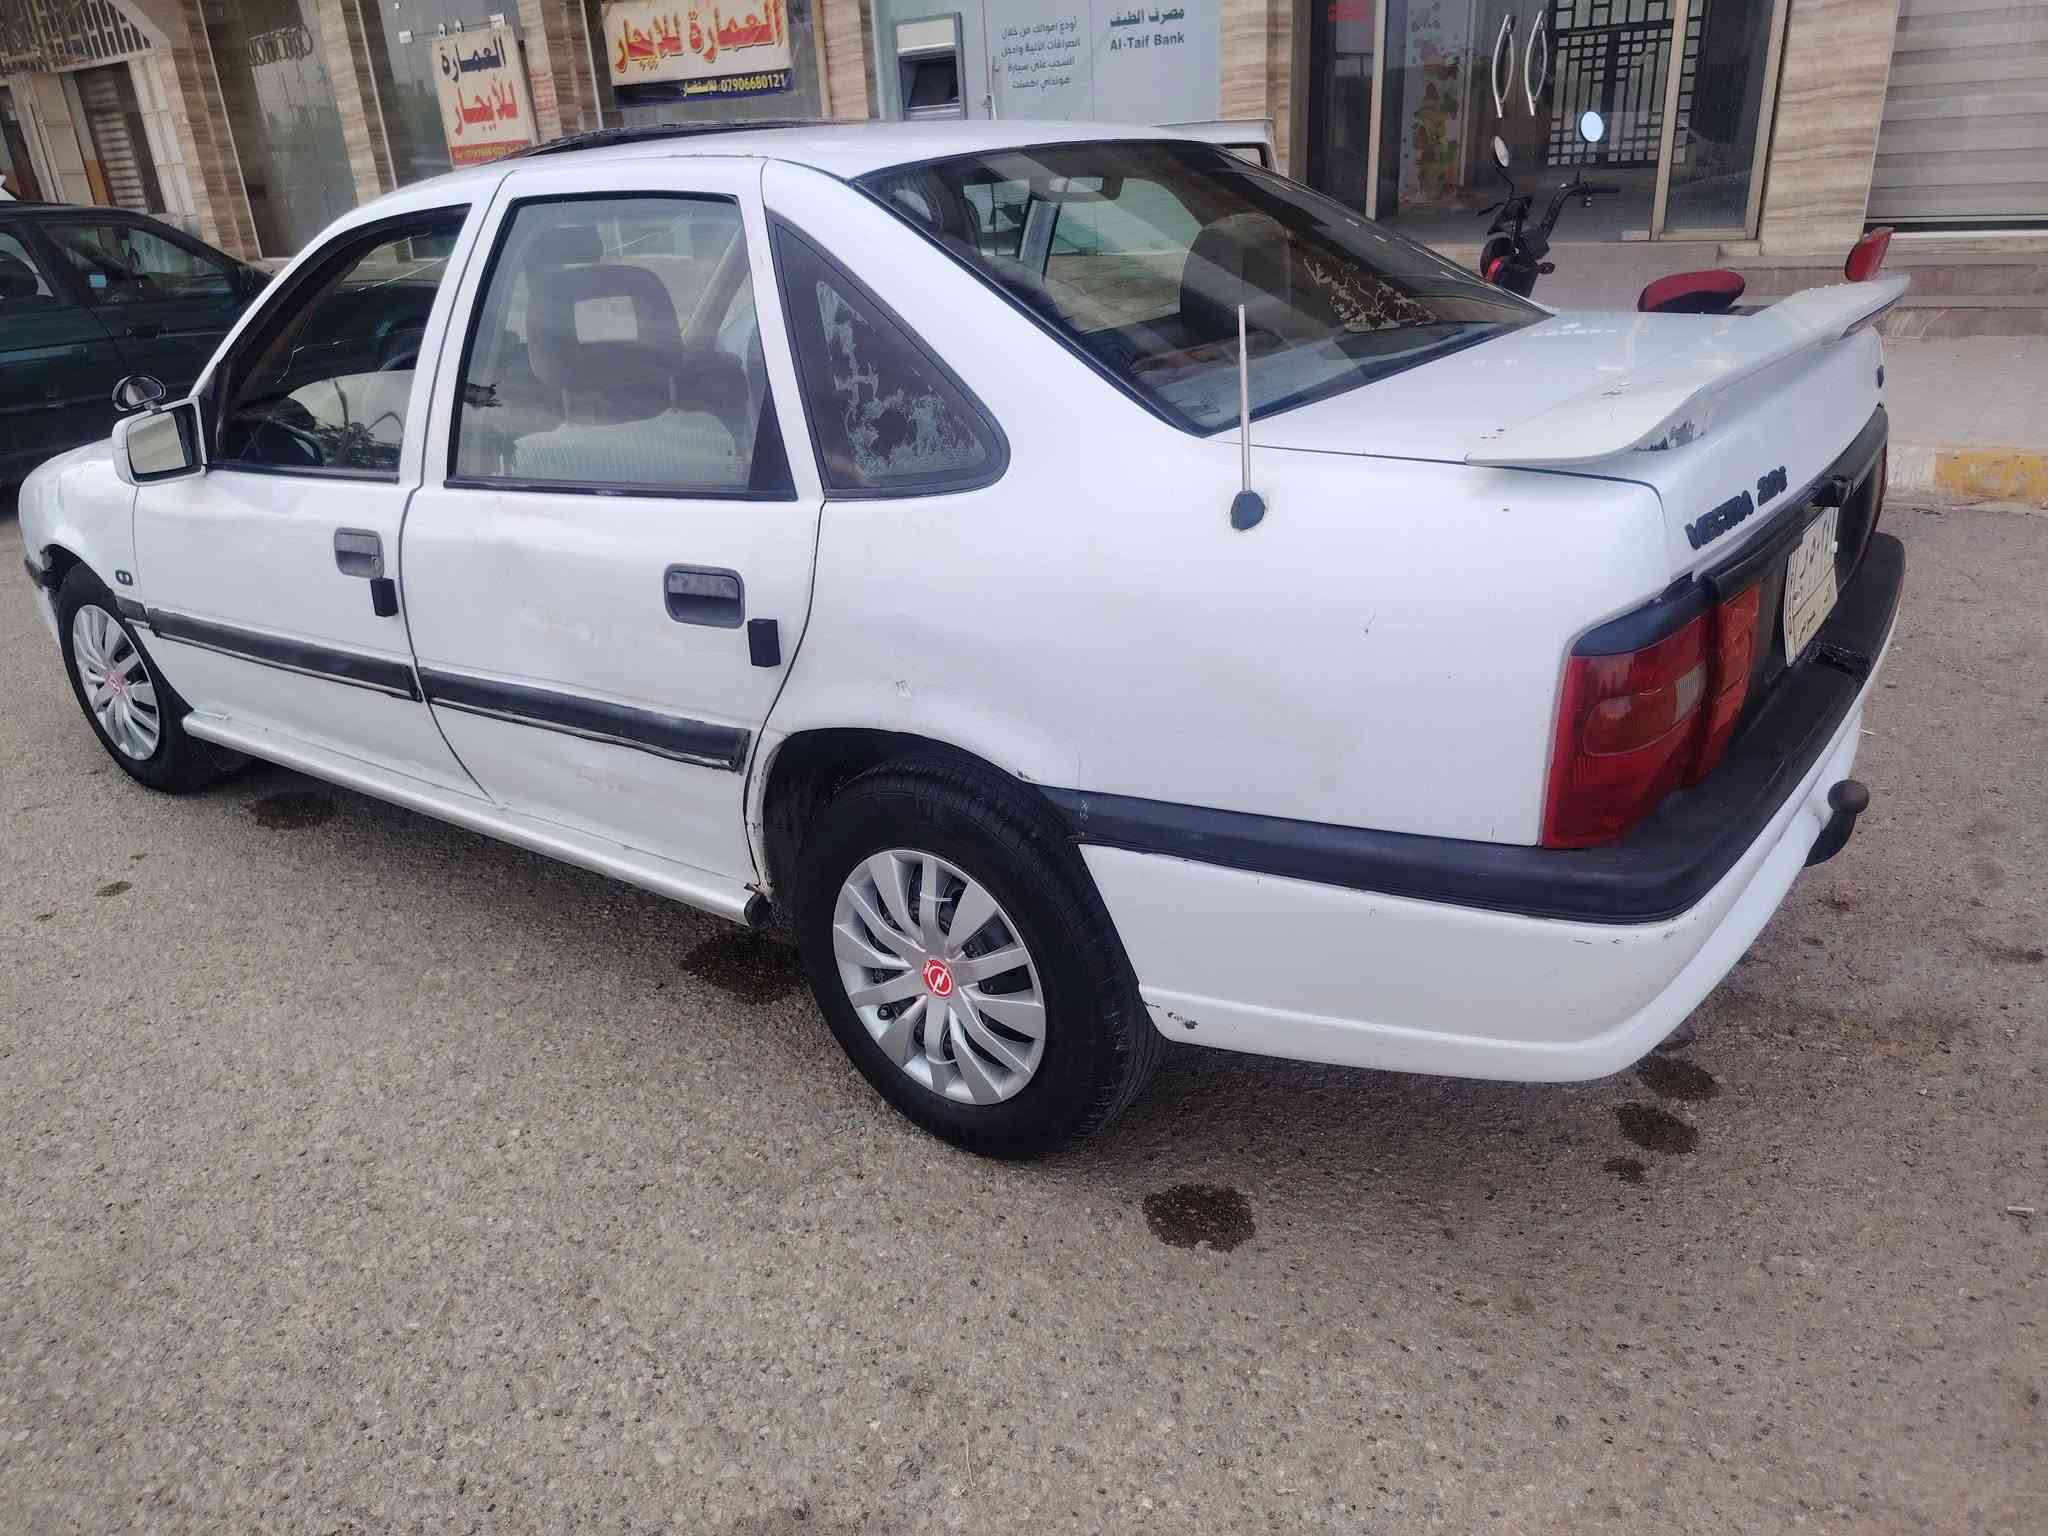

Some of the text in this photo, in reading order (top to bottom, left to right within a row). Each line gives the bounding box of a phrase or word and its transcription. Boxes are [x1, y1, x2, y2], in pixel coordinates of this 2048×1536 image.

[1110, 8, 1185, 29] مصرف الطيف
[1110, 31, 1185, 51] Al-Taif Bank
[440, 35, 507, 83] العمارة
